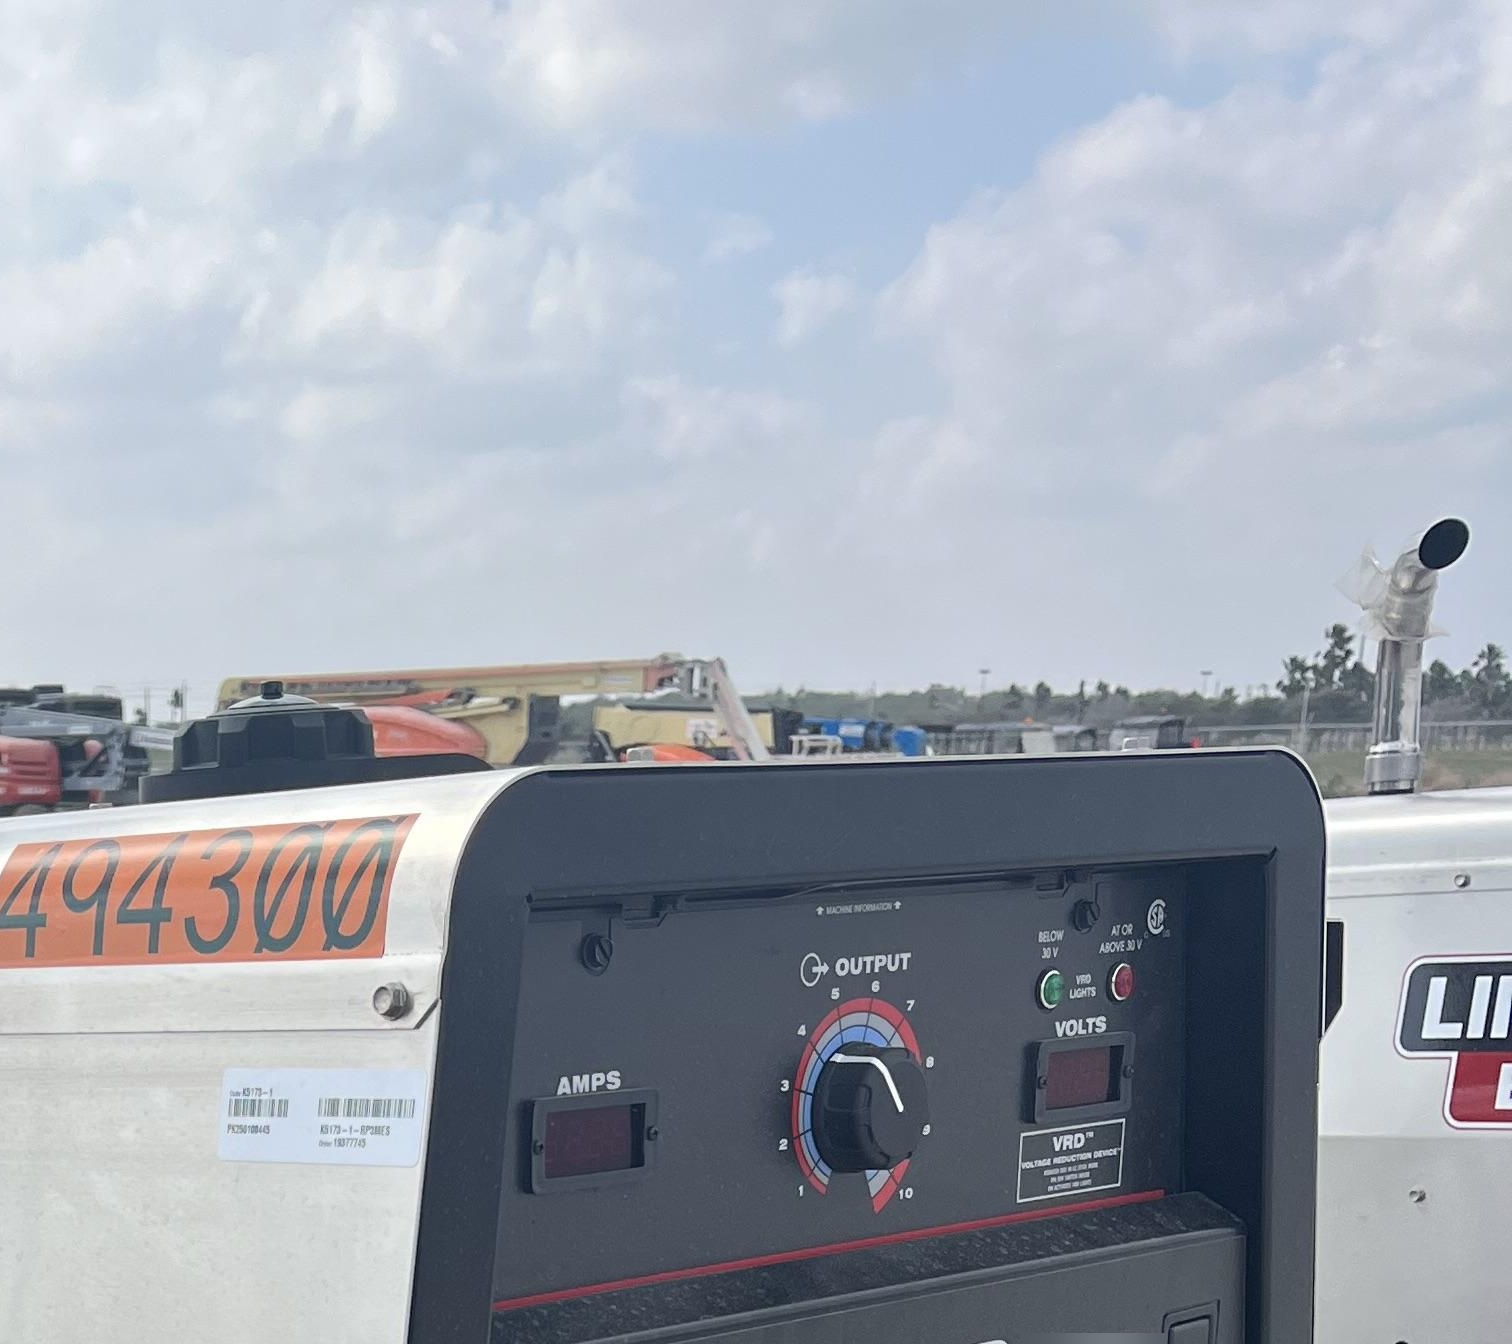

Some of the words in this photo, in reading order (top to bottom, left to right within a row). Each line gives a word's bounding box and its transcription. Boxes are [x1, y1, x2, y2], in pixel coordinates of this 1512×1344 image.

[1038, 929, 1065, 943] BELOW
[1041, 948, 1052, 959] 30
[1099, 941, 1125, 954] ABOVE
[835, 952, 912, 977] OUTPUT
[1075, 974, 1092, 985] VRD
[871, 981, 880, 992] 6
[831, 987, 840, 999] 5
[1069, 987, 1097, 1000] LIGHTS
[905, 1000, 915, 1012] 7
[797, 1025, 807, 1037] 4
[1054, 1016, 1108, 1038] VOLTS
[556, 1070, 622, 1095] AMPS
[780, 1080, 789, 1092] 3
[778, 1138, 788, 1150] 2
[797, 1185, 804, 1197] 1
[898, 1186, 913, 1200] 10
